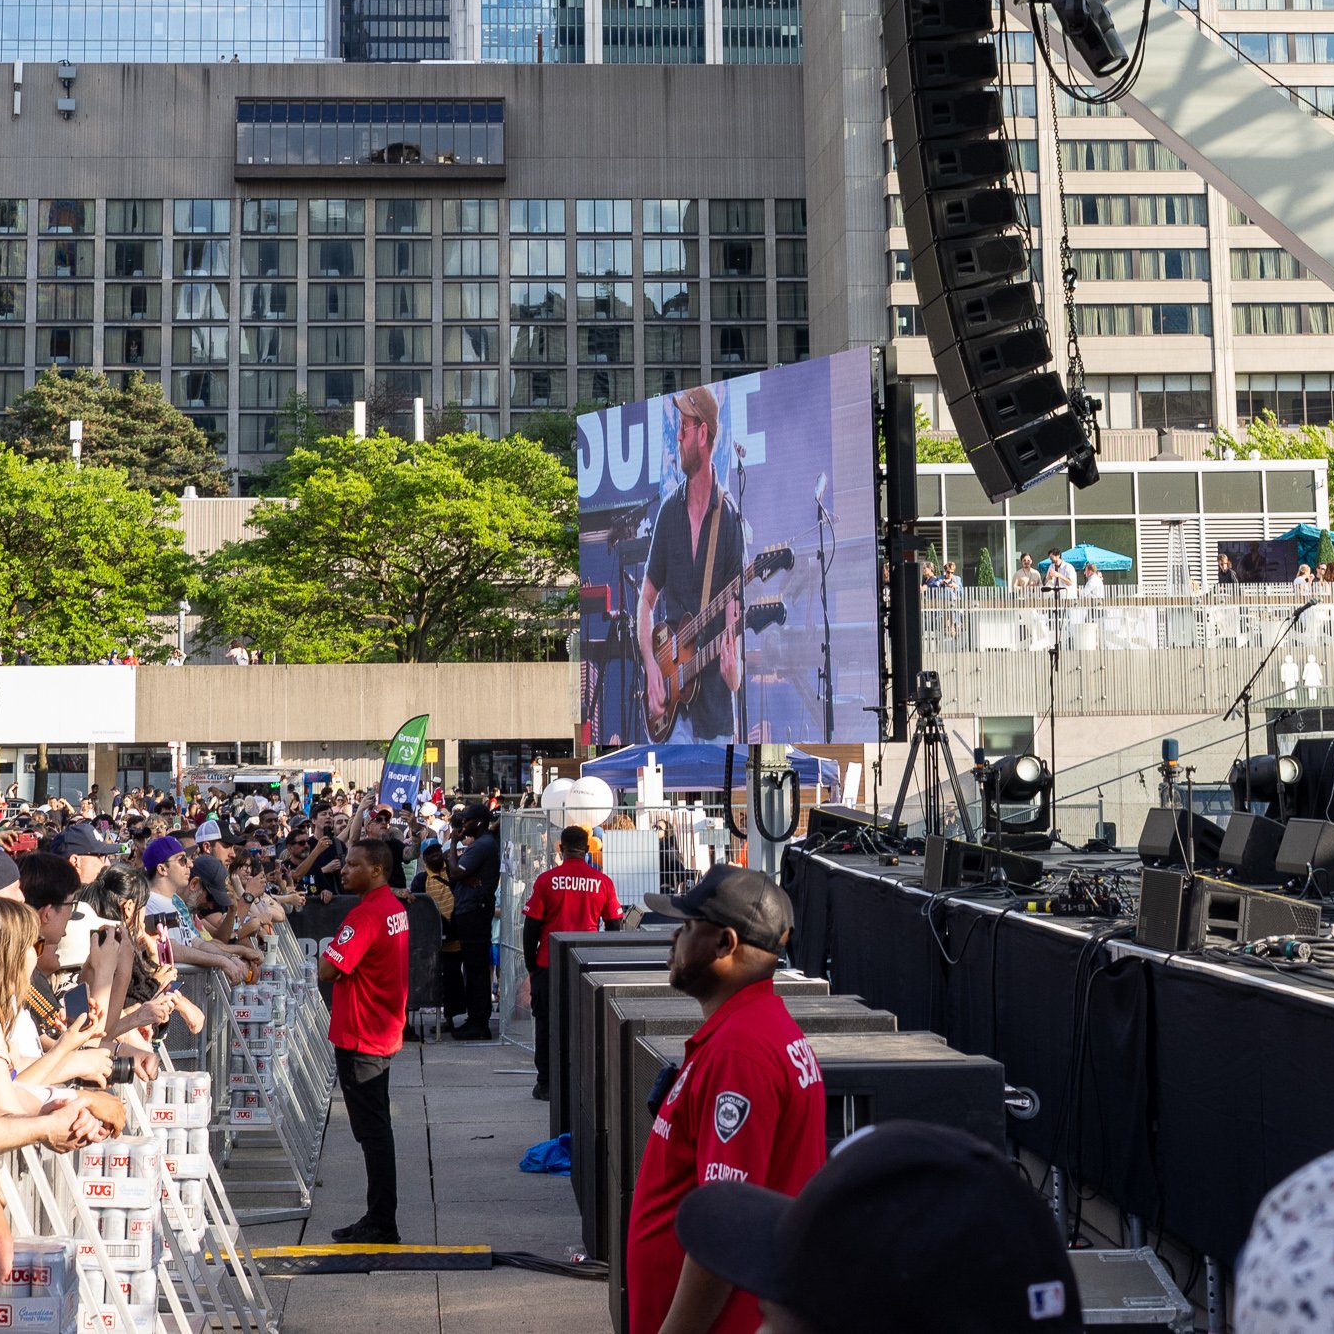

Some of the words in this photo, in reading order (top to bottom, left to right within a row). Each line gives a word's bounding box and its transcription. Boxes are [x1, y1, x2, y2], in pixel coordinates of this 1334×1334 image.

[398, 733, 420, 744] Green
[388, 771, 416, 783] Recycle
[551, 876, 601, 894] SECURITY
[725, 1097, 745, 1108] HOUSE
[153, 1111, 173, 1121] JUG
[86, 1185, 112, 1196] JUG
[132, 1221, 151, 1231] JUG
[18, 1306, 54, 1317] Canadian
